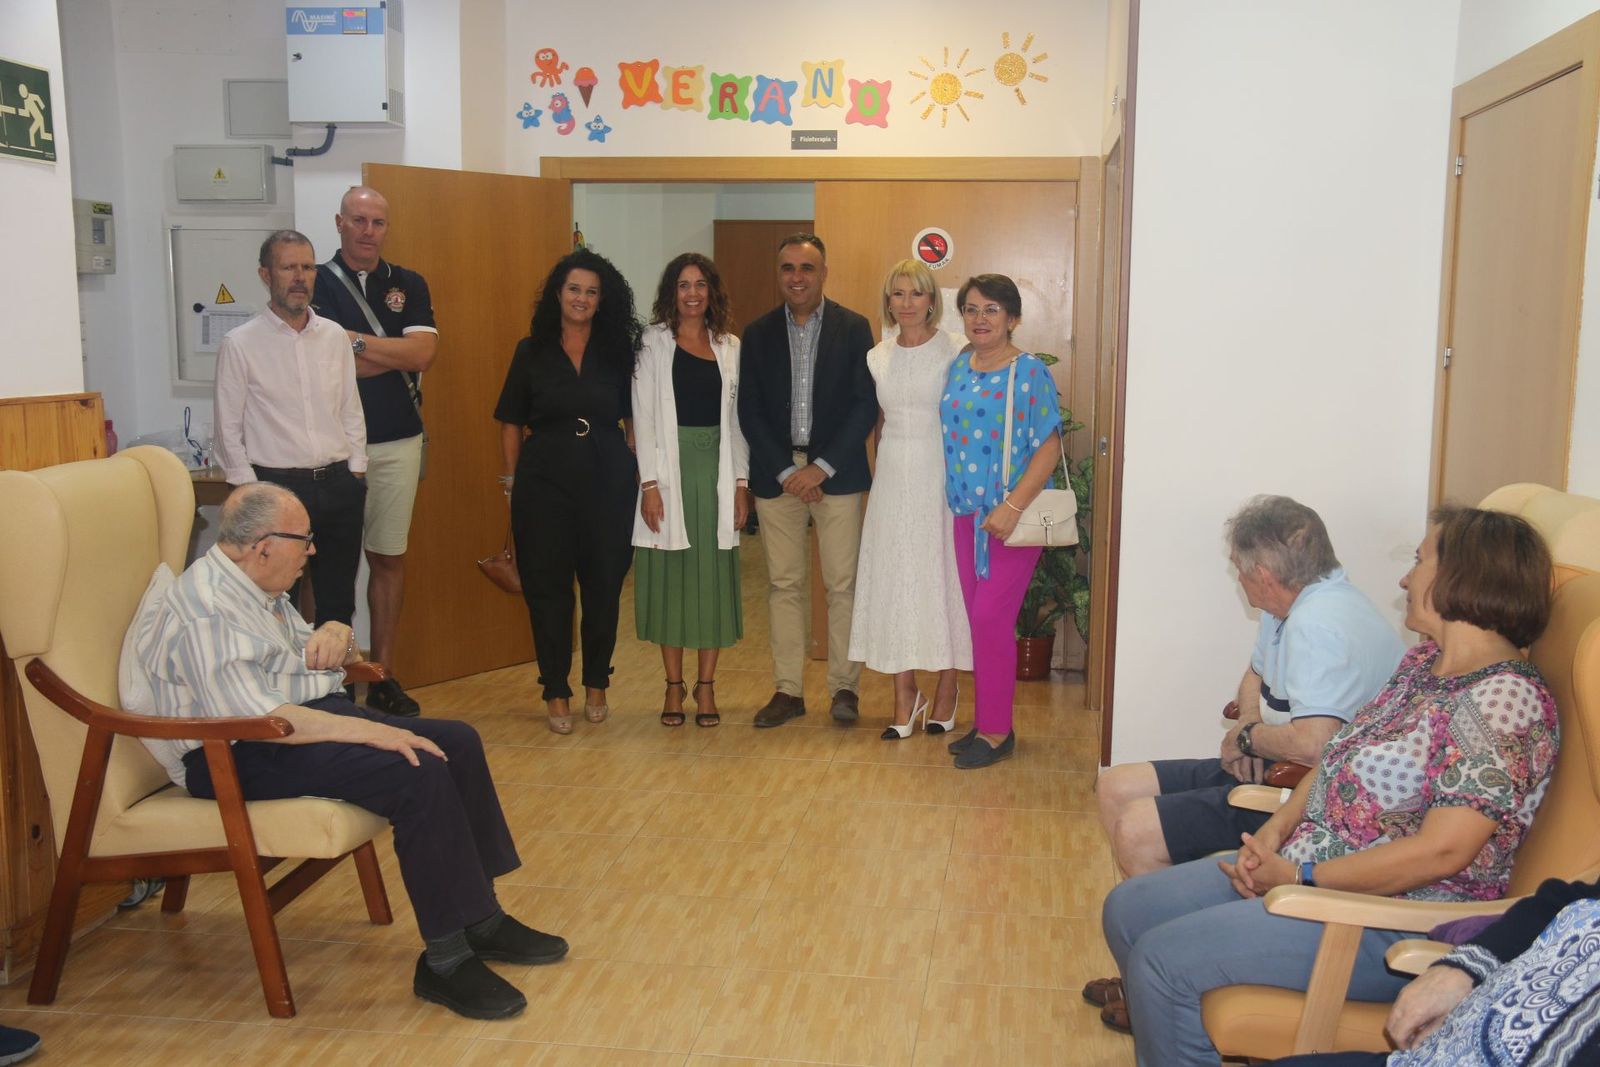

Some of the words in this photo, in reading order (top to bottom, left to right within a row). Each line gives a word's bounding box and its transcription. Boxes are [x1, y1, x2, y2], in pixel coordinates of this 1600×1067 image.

[624, 67, 881, 117] VERANO
[799, 135, 832, 143] Fisioterapia
[928, 257, 950, 269] FUMAR
